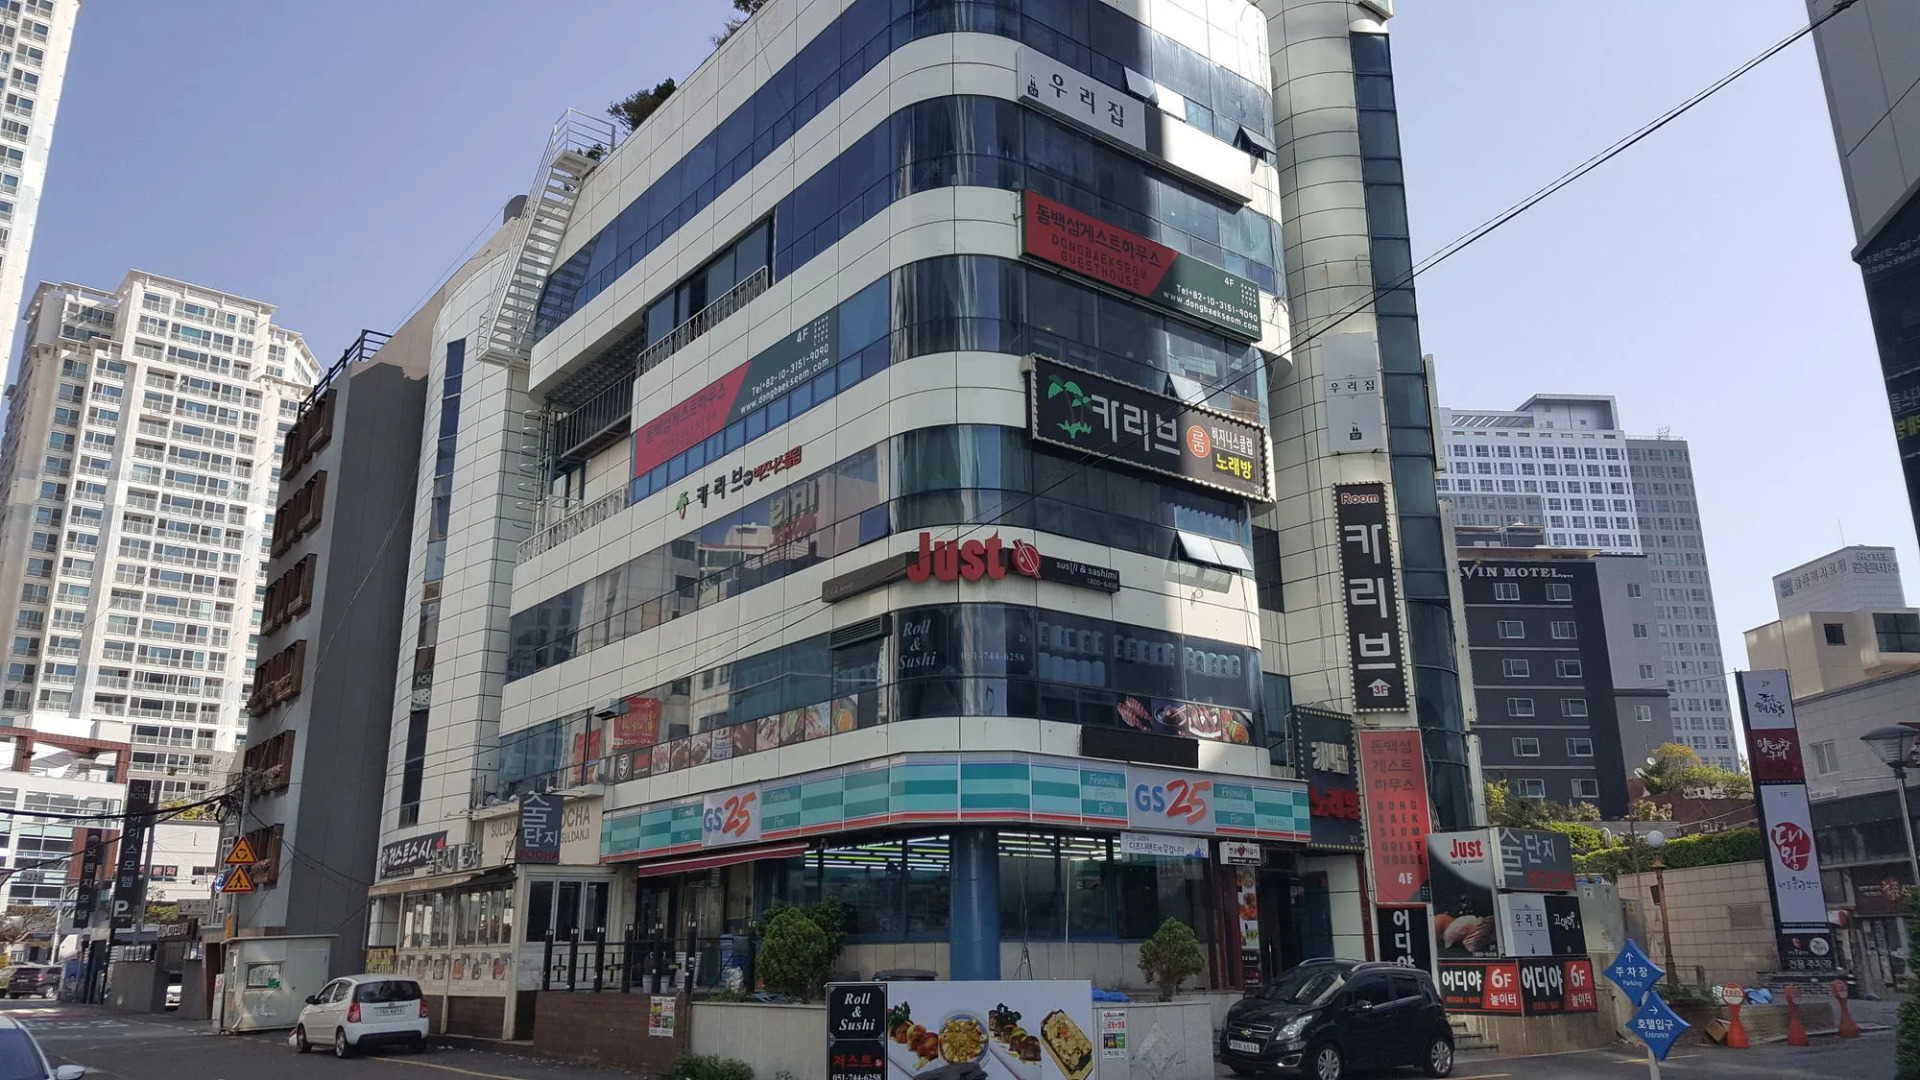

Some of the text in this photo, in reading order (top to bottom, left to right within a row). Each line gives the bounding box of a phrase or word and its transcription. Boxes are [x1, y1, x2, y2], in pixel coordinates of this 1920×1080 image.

[1048, 73, 1124, 128] 우리집
[1060, 251, 1141, 290] GUESTHOUSE
[1224, 277, 1235, 287] 4F
[1162, 291, 1259, 332] www.dongbaekseom.com
[796, 328, 809, 344] 4F
[740, 357, 829, 415] www.dongbaekseom.com
[1329, 378, 1376, 393] 우리집
[1090, 394, 1181, 456] 카리브
[1191, 429, 1205, 454] 룸
[1215, 453, 1253, 481] 노래방
[696, 465, 745, 509] 카리브
[1340, 491, 1380, 505] Room
[906, 528, 1007, 583] Just
[1856, 551, 1889, 562] HOTEL
[1503, 566, 1561, 578] MOTEL
[1344, 523, 1397, 670] 카리브
[902, 619, 932, 636] Roll
[910, 638, 922, 652] &
[899, 650, 938, 670] Sushi
[1373, 684, 1388, 696] 3F
[1372, 759, 1414, 774] 게스트
[1088, 773, 1119, 788] Friendly
[1374, 778, 1416, 791] 하우스
[1221, 786, 1249, 800] Friendly
[1098, 802, 1114, 814] Fun
[1134, 778, 1213, 826] GS25
[521, 792, 559, 848] 술단지
[702, 790, 758, 838] GS25
[1229, 813, 1243, 824] Fun
[1378, 813, 1419, 824] BAEK
[1380, 826, 1421, 837] SEOM
[121, 810, 145, 889] 아이스모텔
[1381, 841, 1422, 851] GUEST
[1450, 837, 1484, 859] Just
[1499, 828, 1557, 877] 술단지
[518, 849, 559, 860] POCHA
[1383, 854, 1425, 865] HOUSE
[1398, 872, 1413, 885] 4F
[112, 900, 129, 918] P
[1514, 912, 1544, 928] 우리집
[1392, 909, 1417, 968] 어디야
[1491, 968, 1512, 988] 6F
[1570, 964, 1586, 988] 6F
[1614, 966, 1648, 978] 주차장
[1441, 969, 1484, 993] 어디야
[1521, 965, 1564, 997] 어디야
[1622, 980, 1643, 988] Parking
[844, 992, 872, 1005] Roll
[1489, 993, 1518, 1007] 놀이터
[1570, 993, 1593, 1008] 놀이터
[851, 1005, 862, 1018] &
[838, 1018, 876, 1031] Sushi
[1637, 1018, 1674, 1031] 호텔입구
[1644, 1031, 1670, 1039] Entrance
